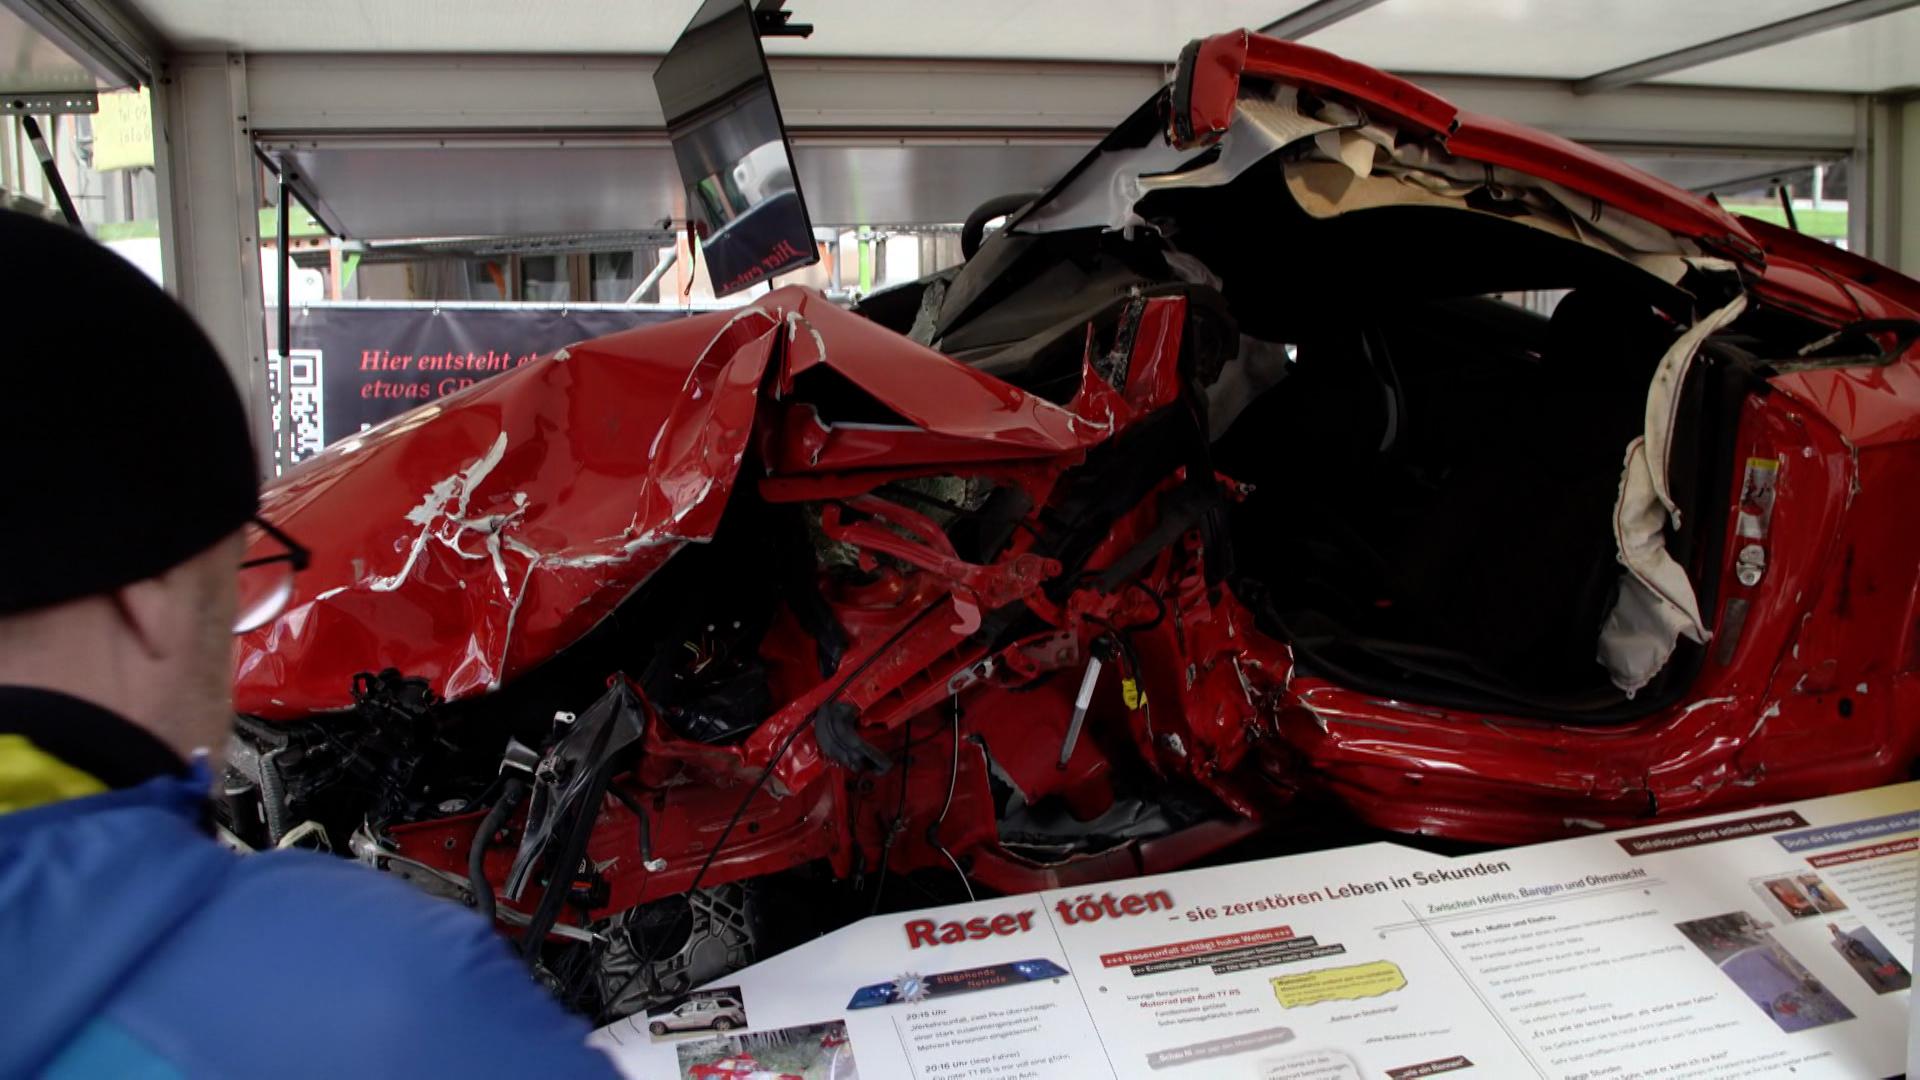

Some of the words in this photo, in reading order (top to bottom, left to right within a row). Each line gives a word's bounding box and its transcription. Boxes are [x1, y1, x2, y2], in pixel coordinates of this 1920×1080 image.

[360, 350, 412, 371] Hier
[418, 350, 511, 371] entsteht
[360, 379, 430, 399] etwas
[1427, 897, 1477, 913] Zwischen
[1477, 891, 1520, 905] Hoffen,
[1519, 883, 1564, 898] Bangen
[1564, 879, 1586, 890] und
[1585, 868, 1647, 887] Ohnmacht
[904, 908, 1036, 950] Raser
[1055, 889, 1174, 926] töten
[1186, 906, 1218, 922] sie
[1224, 890, 1323, 917] zerstören
[1324, 880, 1388, 901] Leben
[1389, 874, 1411, 891] in
[1412, 861, 1511, 886] Sekunden
[1124, 946, 1180, 962] Raserunfall
[1181, 942, 1217, 954] schlägt
[1217, 936, 1241, 948] hohe
[1241, 932, 1273, 943] Wellen
[1140, 998, 1178, 1008] Motorrad
[1179, 995, 1195, 1004] jagt
[1197, 992, 1216, 1000] Audi
[906, 1011, 930, 1021] 20:15
[932, 1009, 948, 1017] Uhr
[925, 1061, 950, 1073] 20:16
[952, 1060, 968, 1068] Uhr
